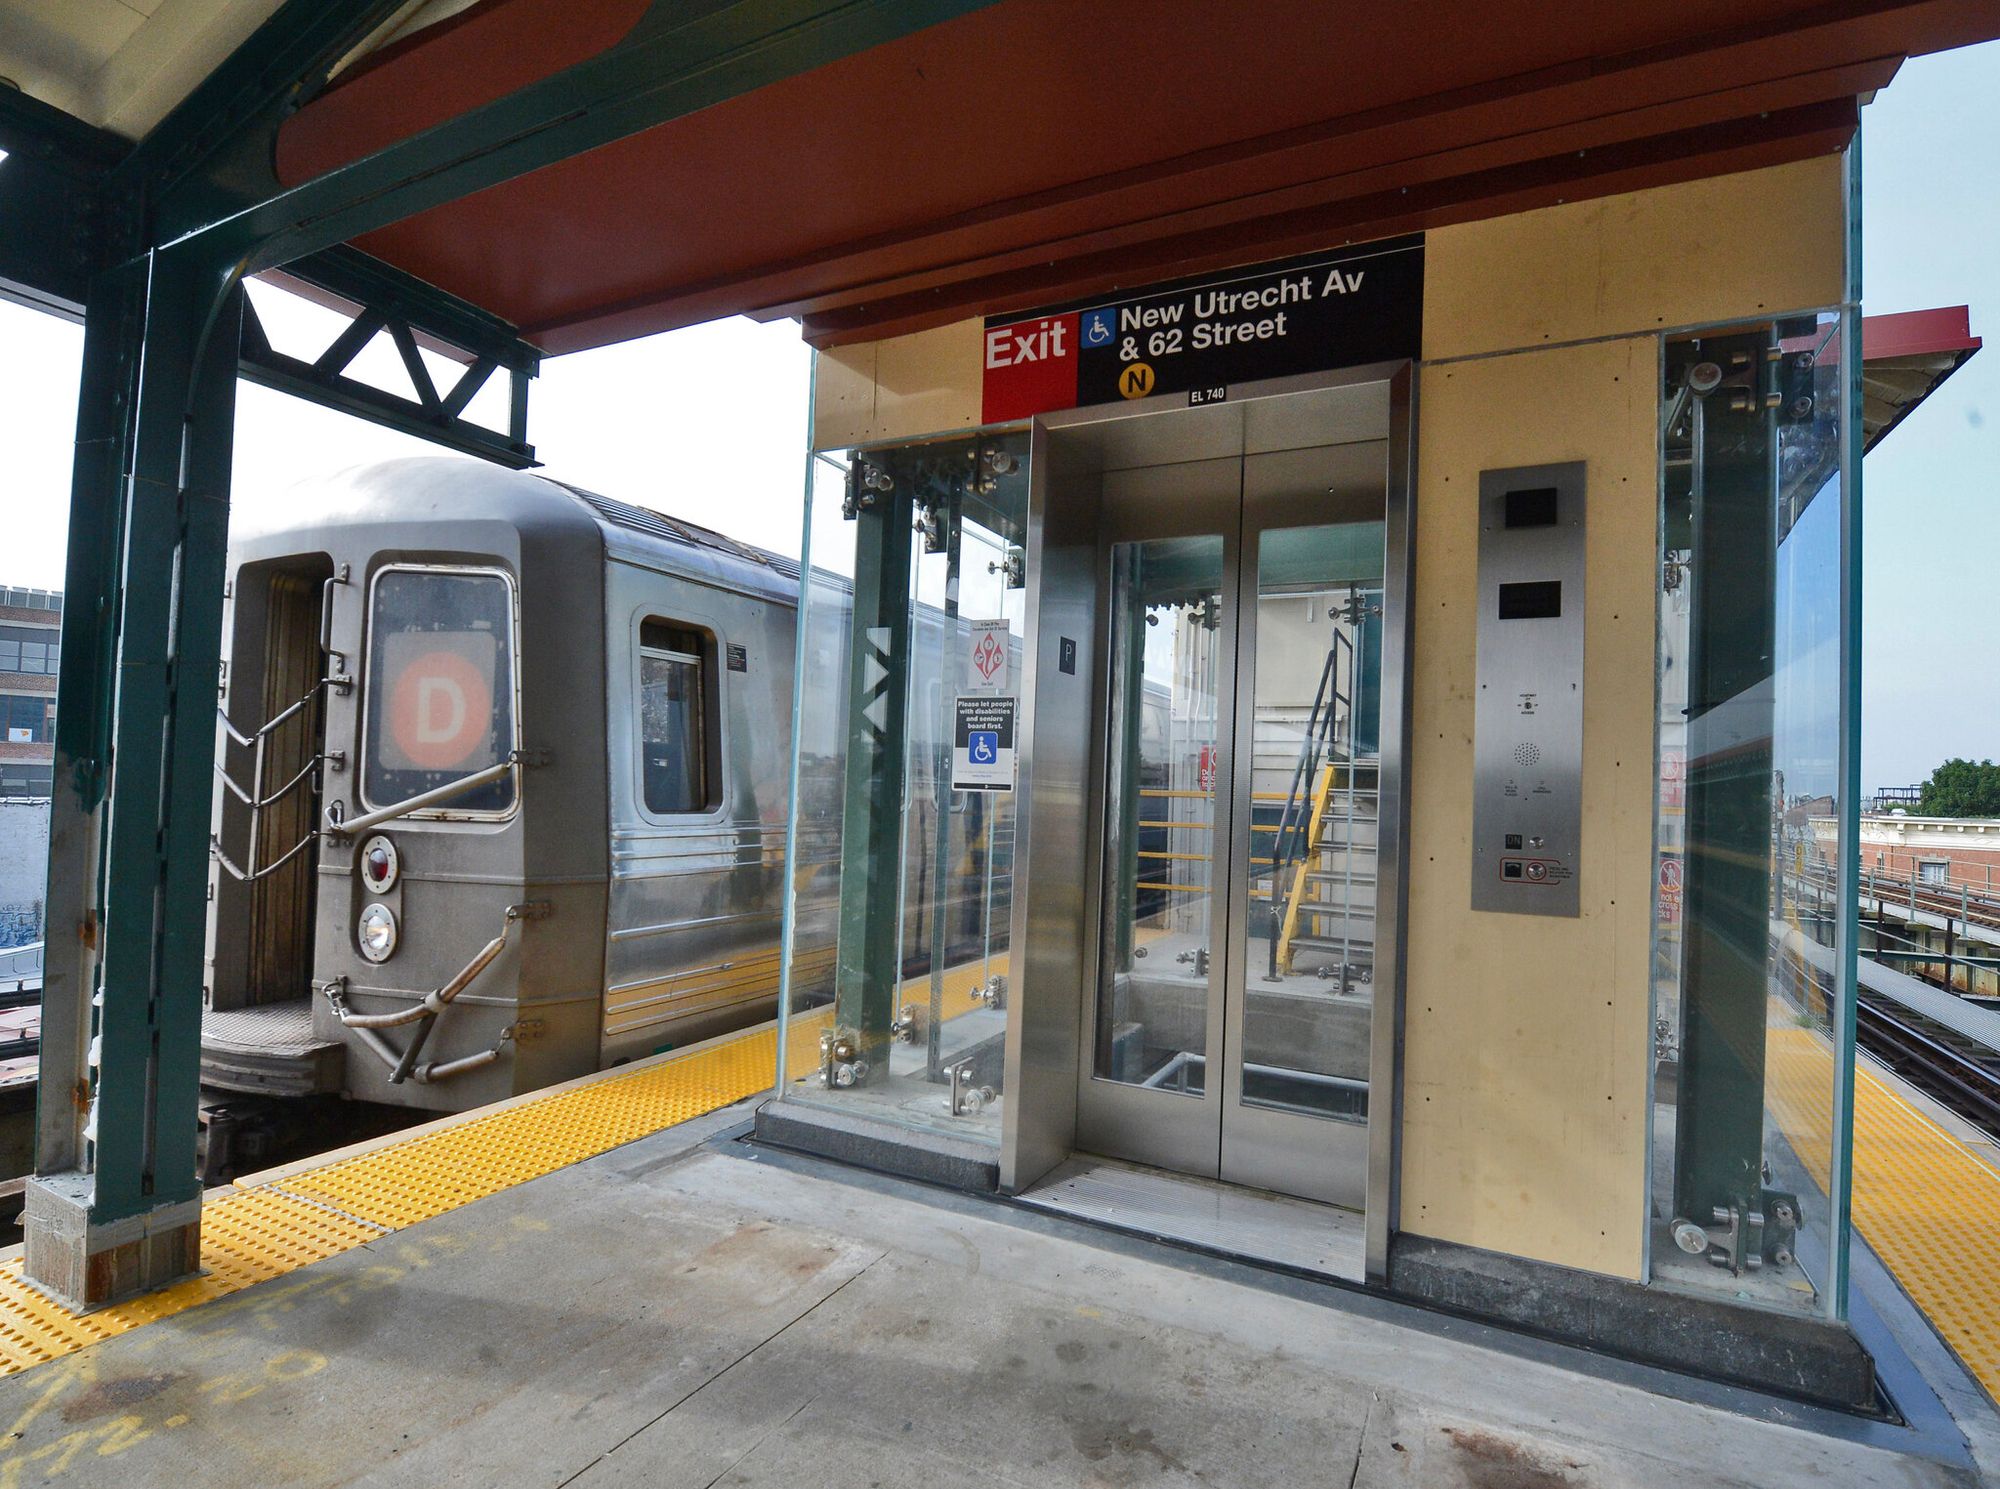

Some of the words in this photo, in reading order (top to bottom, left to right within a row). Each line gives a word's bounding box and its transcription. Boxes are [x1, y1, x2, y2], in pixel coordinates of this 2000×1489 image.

[1121, 303, 1184, 332] New
[1194, 276, 1312, 318] Utrecht
[1321, 269, 1364, 297] Av
[986, 321, 1066, 369] Exit
[1119, 336, 1140, 361] &
[1149, 328, 1183, 356] 62
[1191, 312, 1287, 349] Street
[1128, 369, 1146, 393] N
[1191, 392, 1204, 402] EL
[1206, 388, 1224, 400] 740
[416, 677, 466, 744] D
[990, 701, 1013, 709] people
